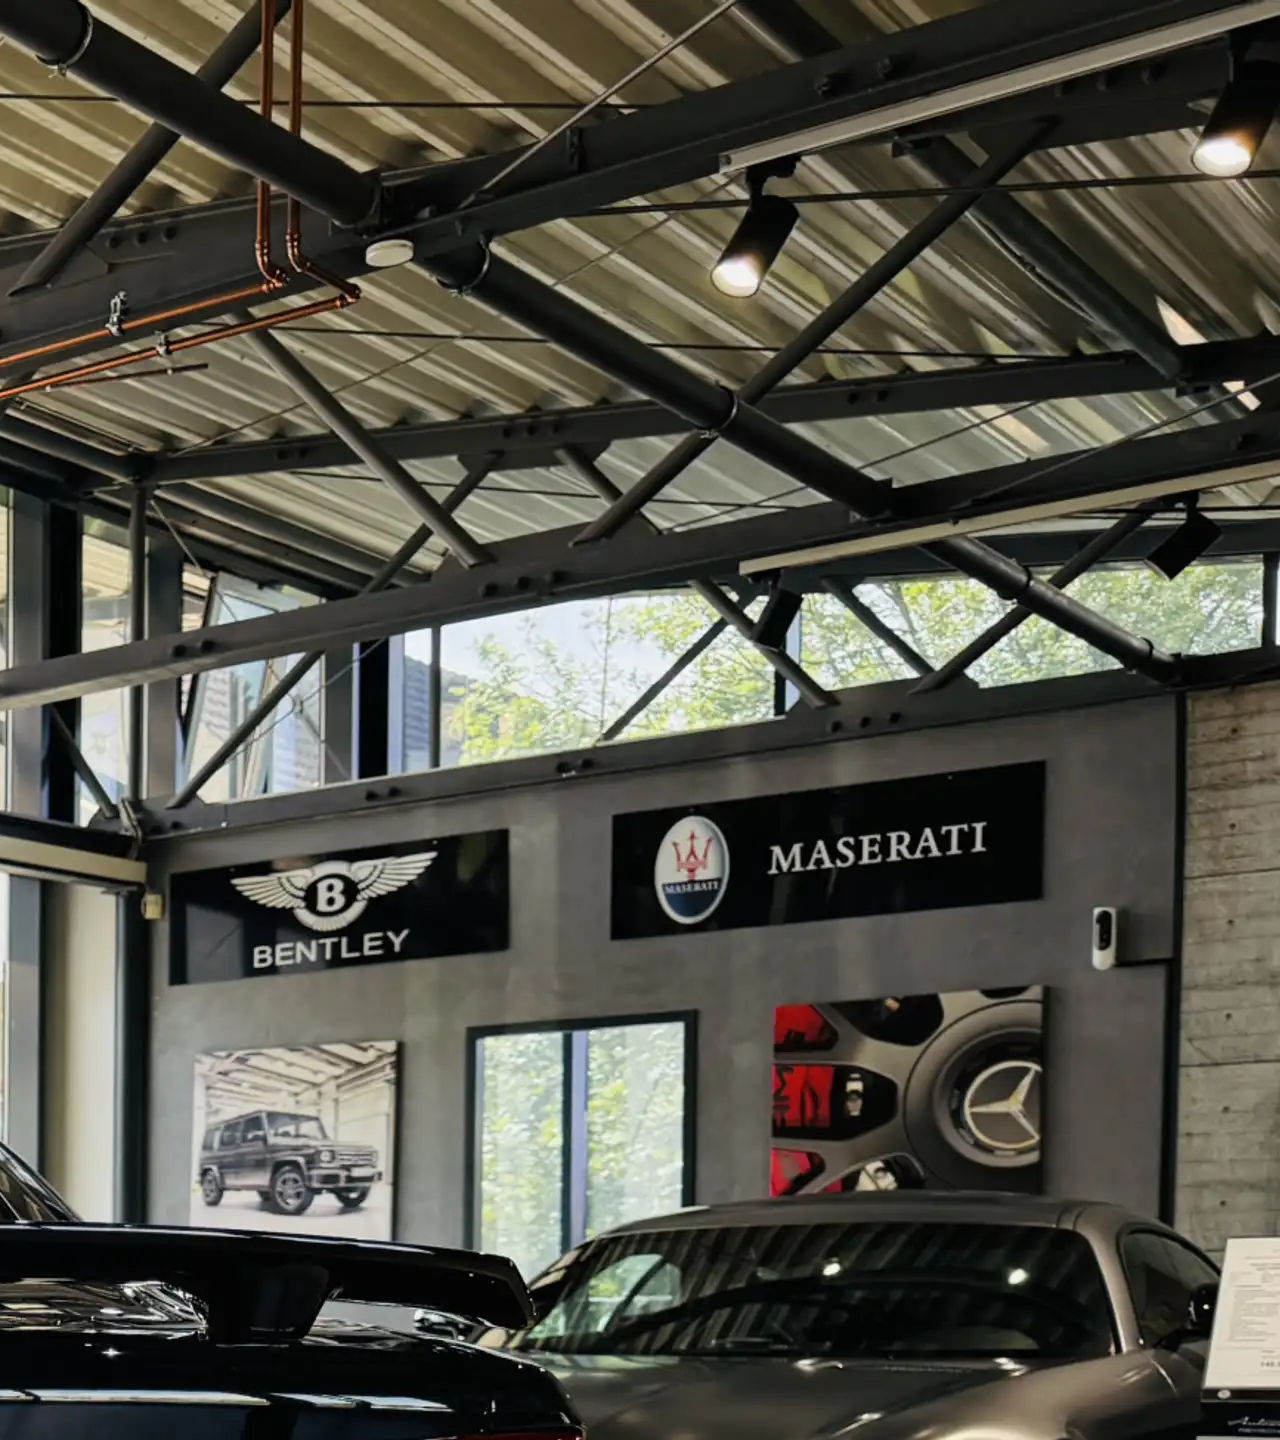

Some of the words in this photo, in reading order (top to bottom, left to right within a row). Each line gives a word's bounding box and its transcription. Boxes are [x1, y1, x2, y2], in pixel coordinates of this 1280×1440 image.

[766, 820, 988, 875] MASERATI
[316, 877, 346, 913] B
[663, 880, 720, 895] MASERATI
[252, 928, 411, 970] BENTLEY
